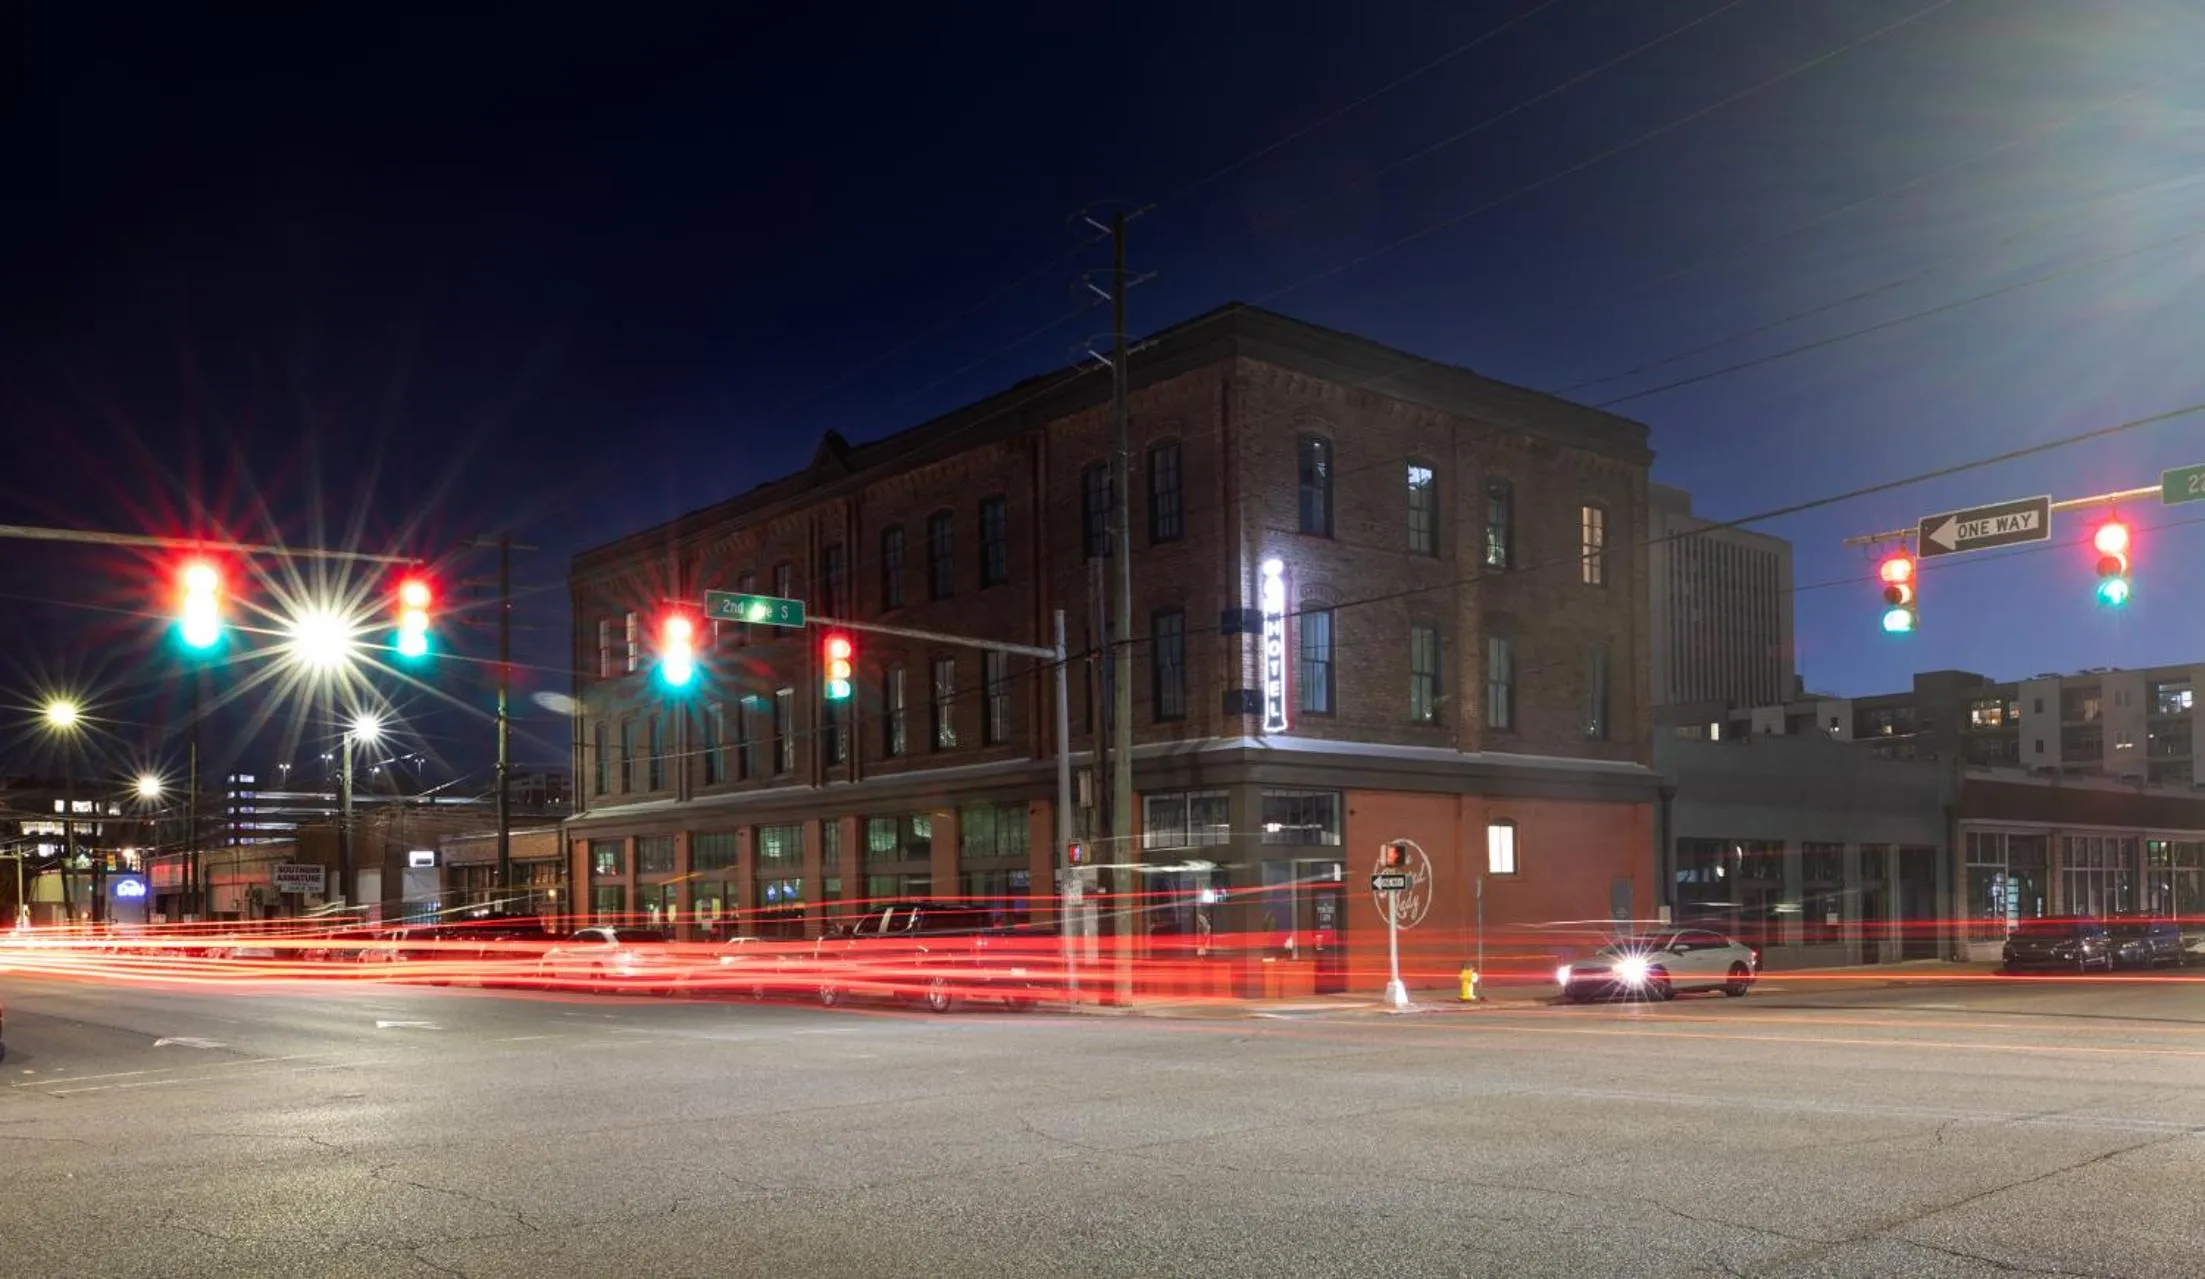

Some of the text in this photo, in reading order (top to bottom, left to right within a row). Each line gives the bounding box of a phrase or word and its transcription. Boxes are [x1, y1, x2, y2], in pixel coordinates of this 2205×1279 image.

[1957, 513, 2032, 538] ONE WAY
[722, 599, 744, 614] 2nd
[781, 605, 789, 620] S
[1267, 621, 1281, 717] HOTEL
